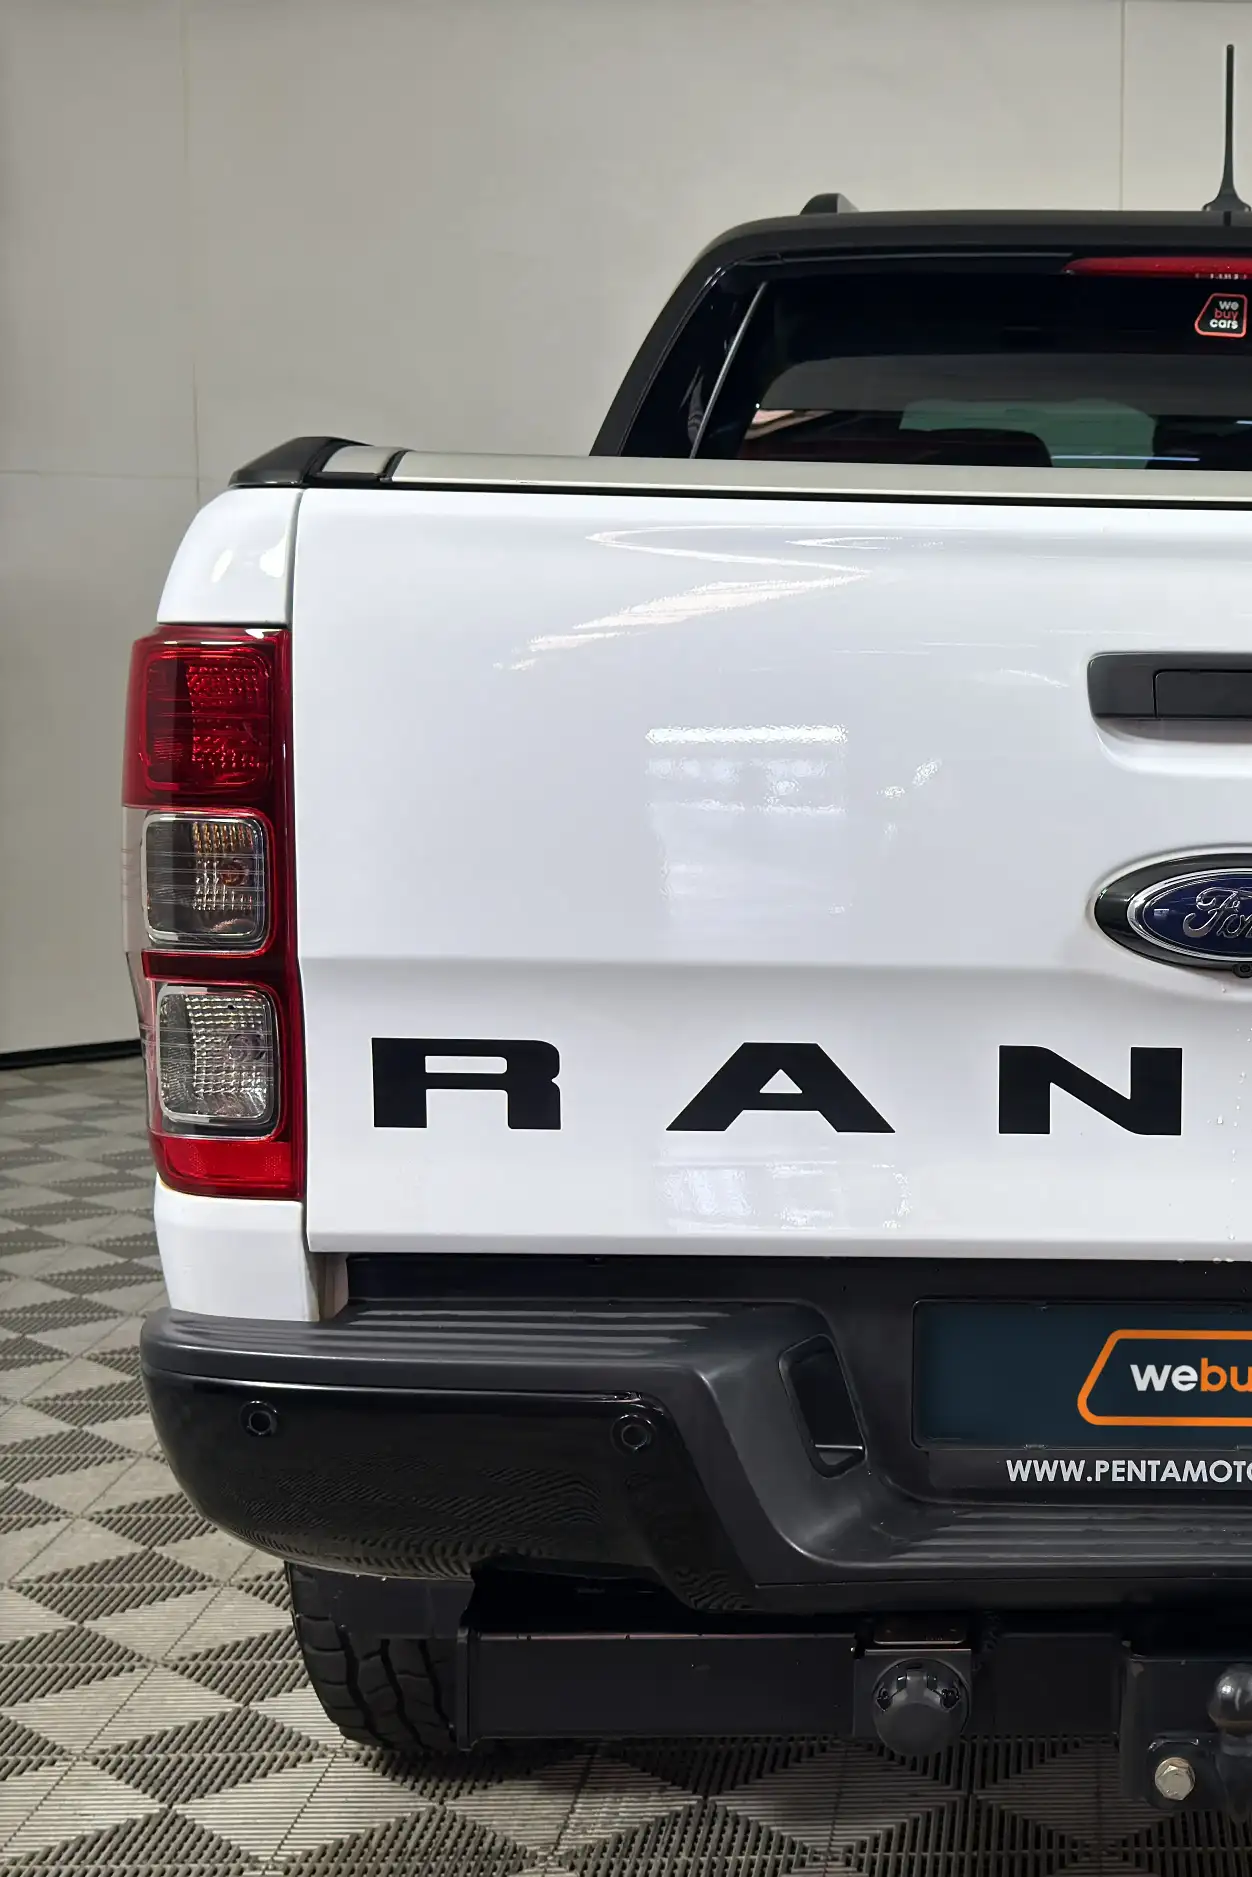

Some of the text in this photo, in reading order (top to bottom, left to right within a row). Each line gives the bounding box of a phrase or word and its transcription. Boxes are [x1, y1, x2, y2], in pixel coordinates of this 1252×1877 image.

[1219, 301, 1239, 310] we
[1214, 308, 1239, 320] buy
[1209, 319, 1239, 329] cars
